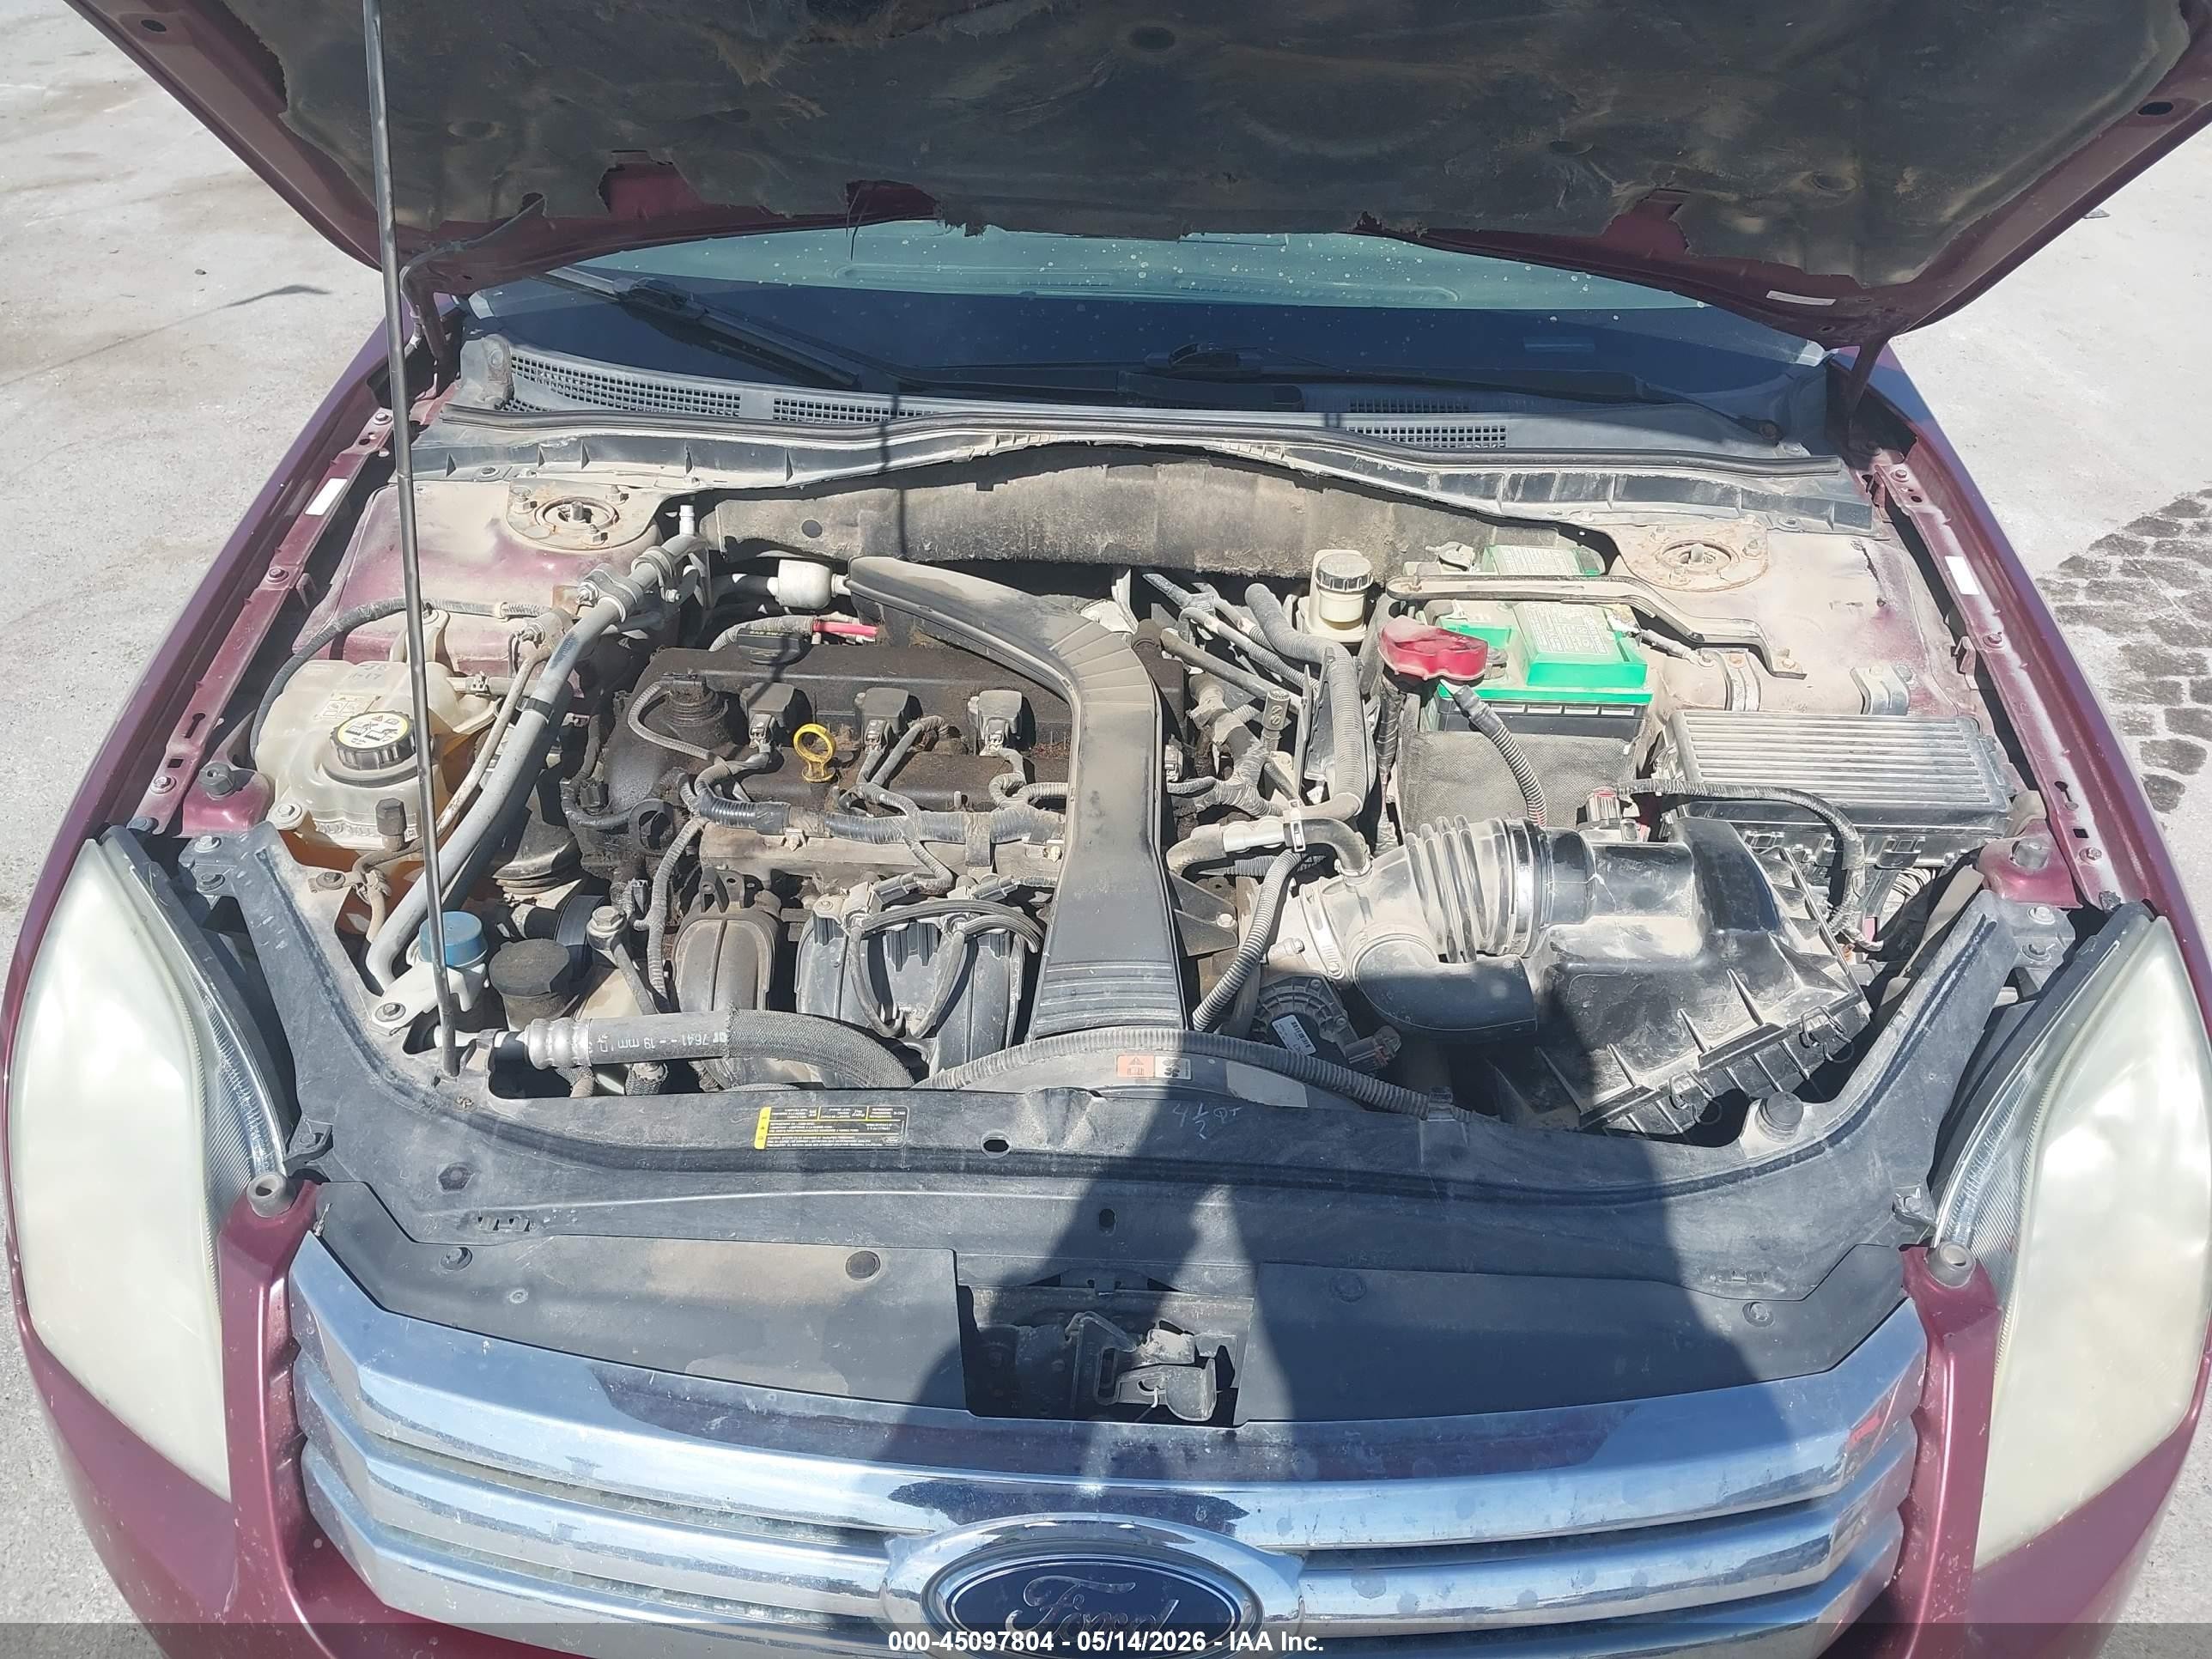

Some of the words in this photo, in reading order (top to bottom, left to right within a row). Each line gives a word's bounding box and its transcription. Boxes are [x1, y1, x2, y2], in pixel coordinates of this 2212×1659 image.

[617, 1039, 640, 1049] mm
[643, 1037, 655, 1049] 19
[1005, 1575, 1179, 1642] Ford
